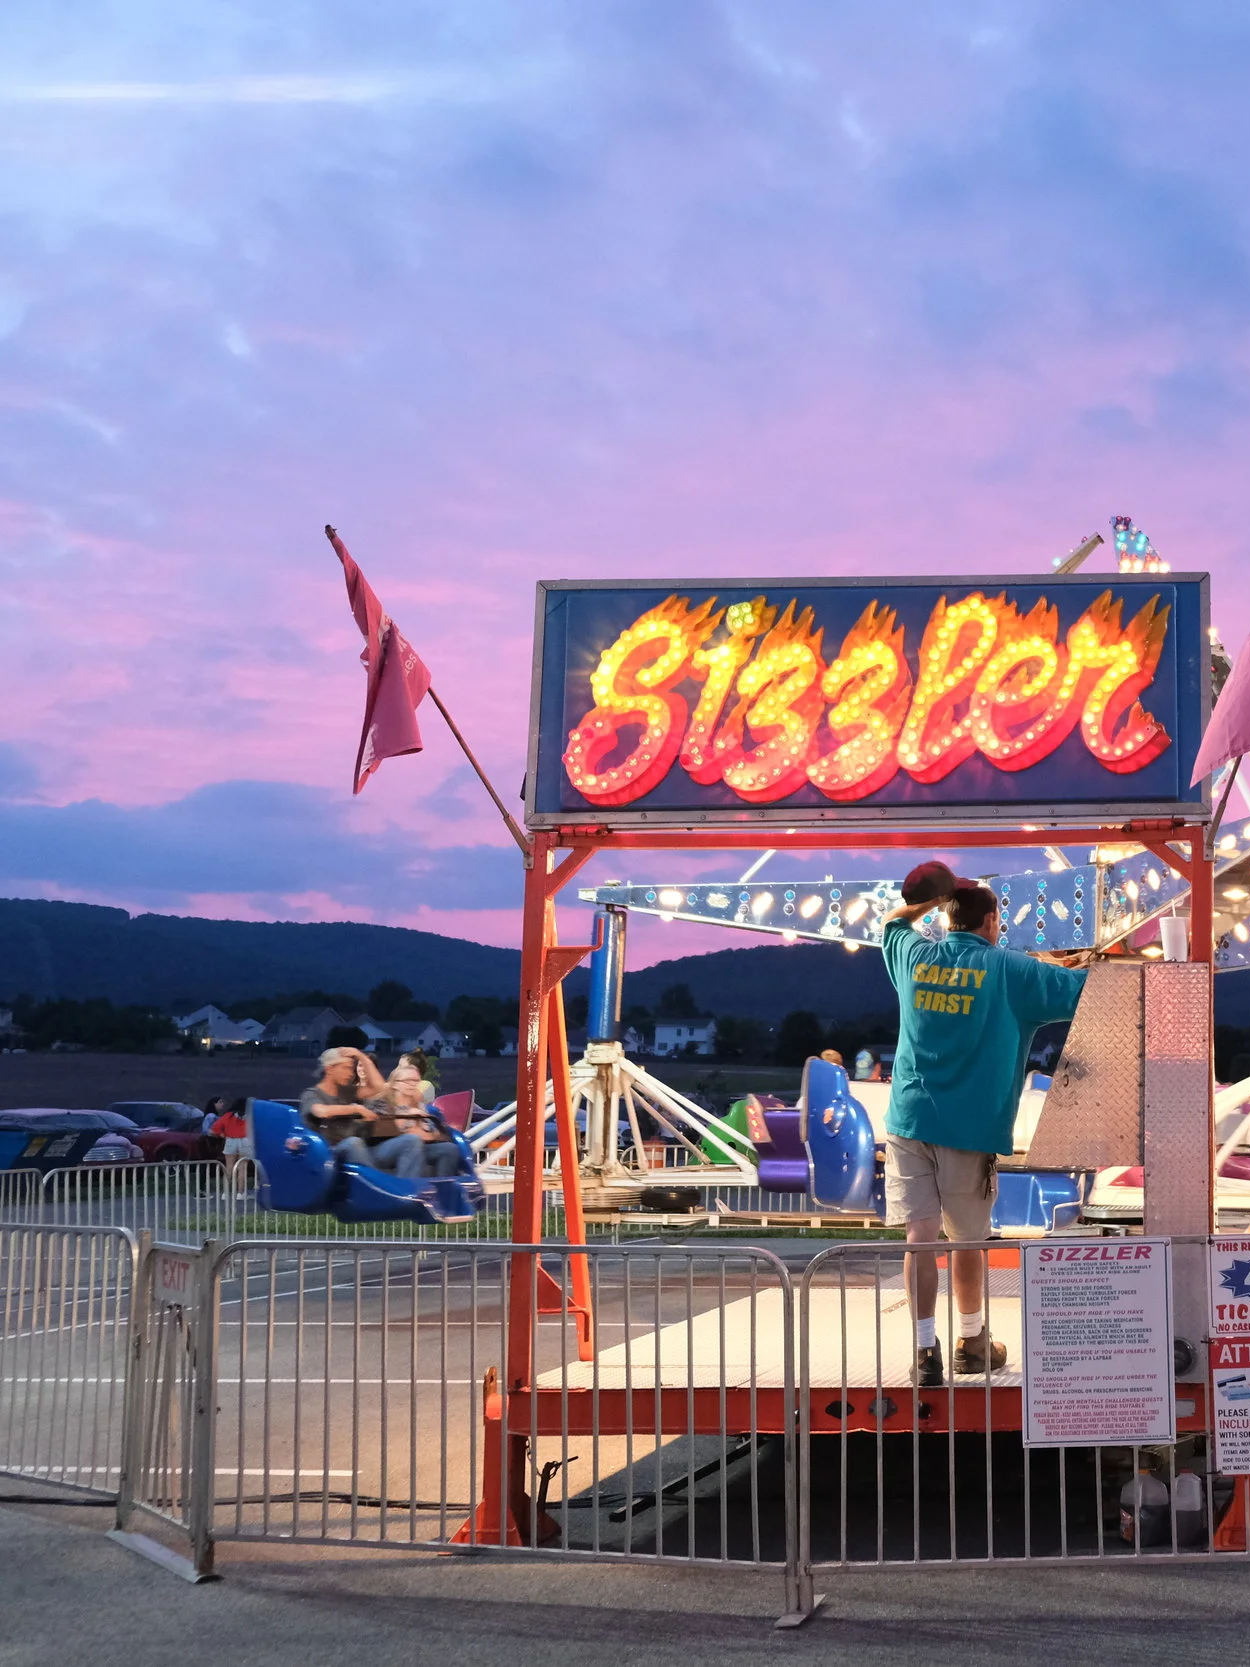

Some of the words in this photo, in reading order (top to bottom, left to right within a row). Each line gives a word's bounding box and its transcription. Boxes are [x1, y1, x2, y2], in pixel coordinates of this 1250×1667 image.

[562, 592, 1171, 806] Sizzler
[912, 962, 987, 989] SAFETY
[914, 990, 974, 1015] FIRST
[1039, 1246, 1152, 1262] SIZZLER
[1216, 1242, 1239, 1252] THIS
[162, 1258, 190, 1293] EXIT
[1218, 1409, 1248, 1417] PLEASE
